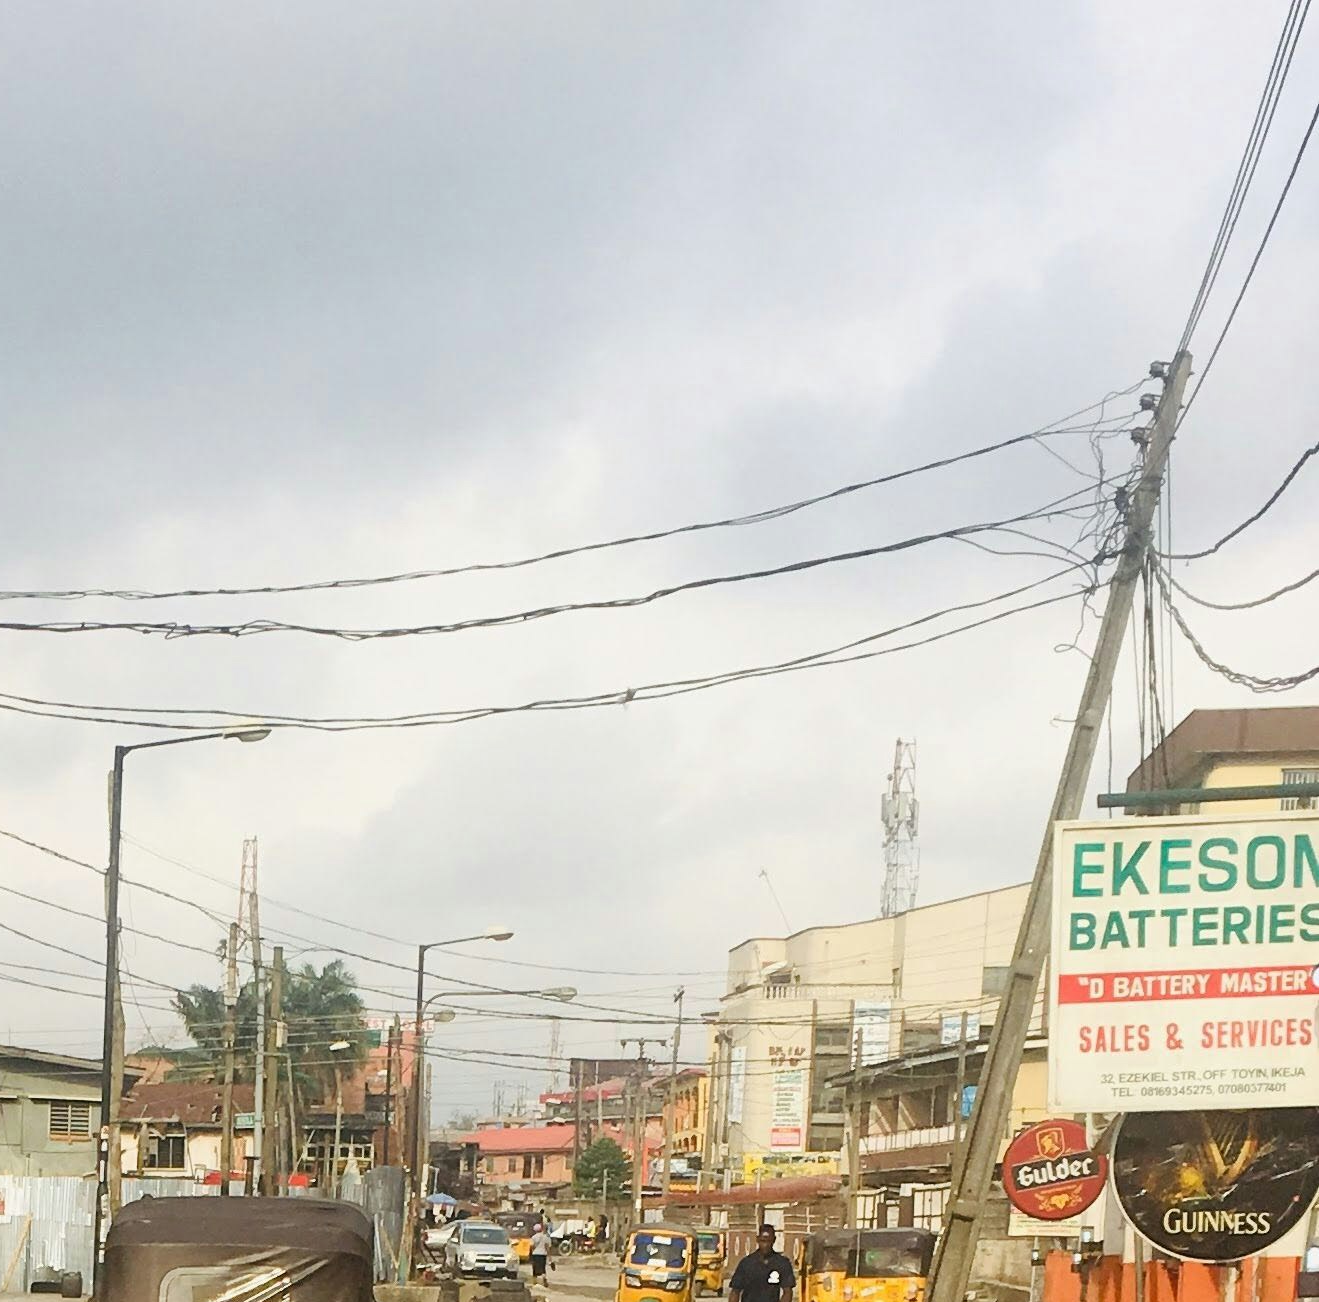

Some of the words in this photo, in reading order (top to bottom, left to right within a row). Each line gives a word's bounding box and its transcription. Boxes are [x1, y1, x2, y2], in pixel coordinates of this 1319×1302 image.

[1069, 903, 1319, 951] BATTERIES
[1113, 973, 1211, 999] BATTERY
[1079, 1024, 1151, 1053] SALES
[1166, 1023, 1185, 1050] &
[1201, 1018, 1313, 1049] SERVICES
[1119, 1072, 1169, 1083] EZEKIEL
[1203, 1069, 1226, 1080] OFF
[1272, 1066, 1306, 1078] IKEJA
[1017, 1158, 1094, 1187] Gulder
[1163, 1208, 1271, 1236] GUINNESS
